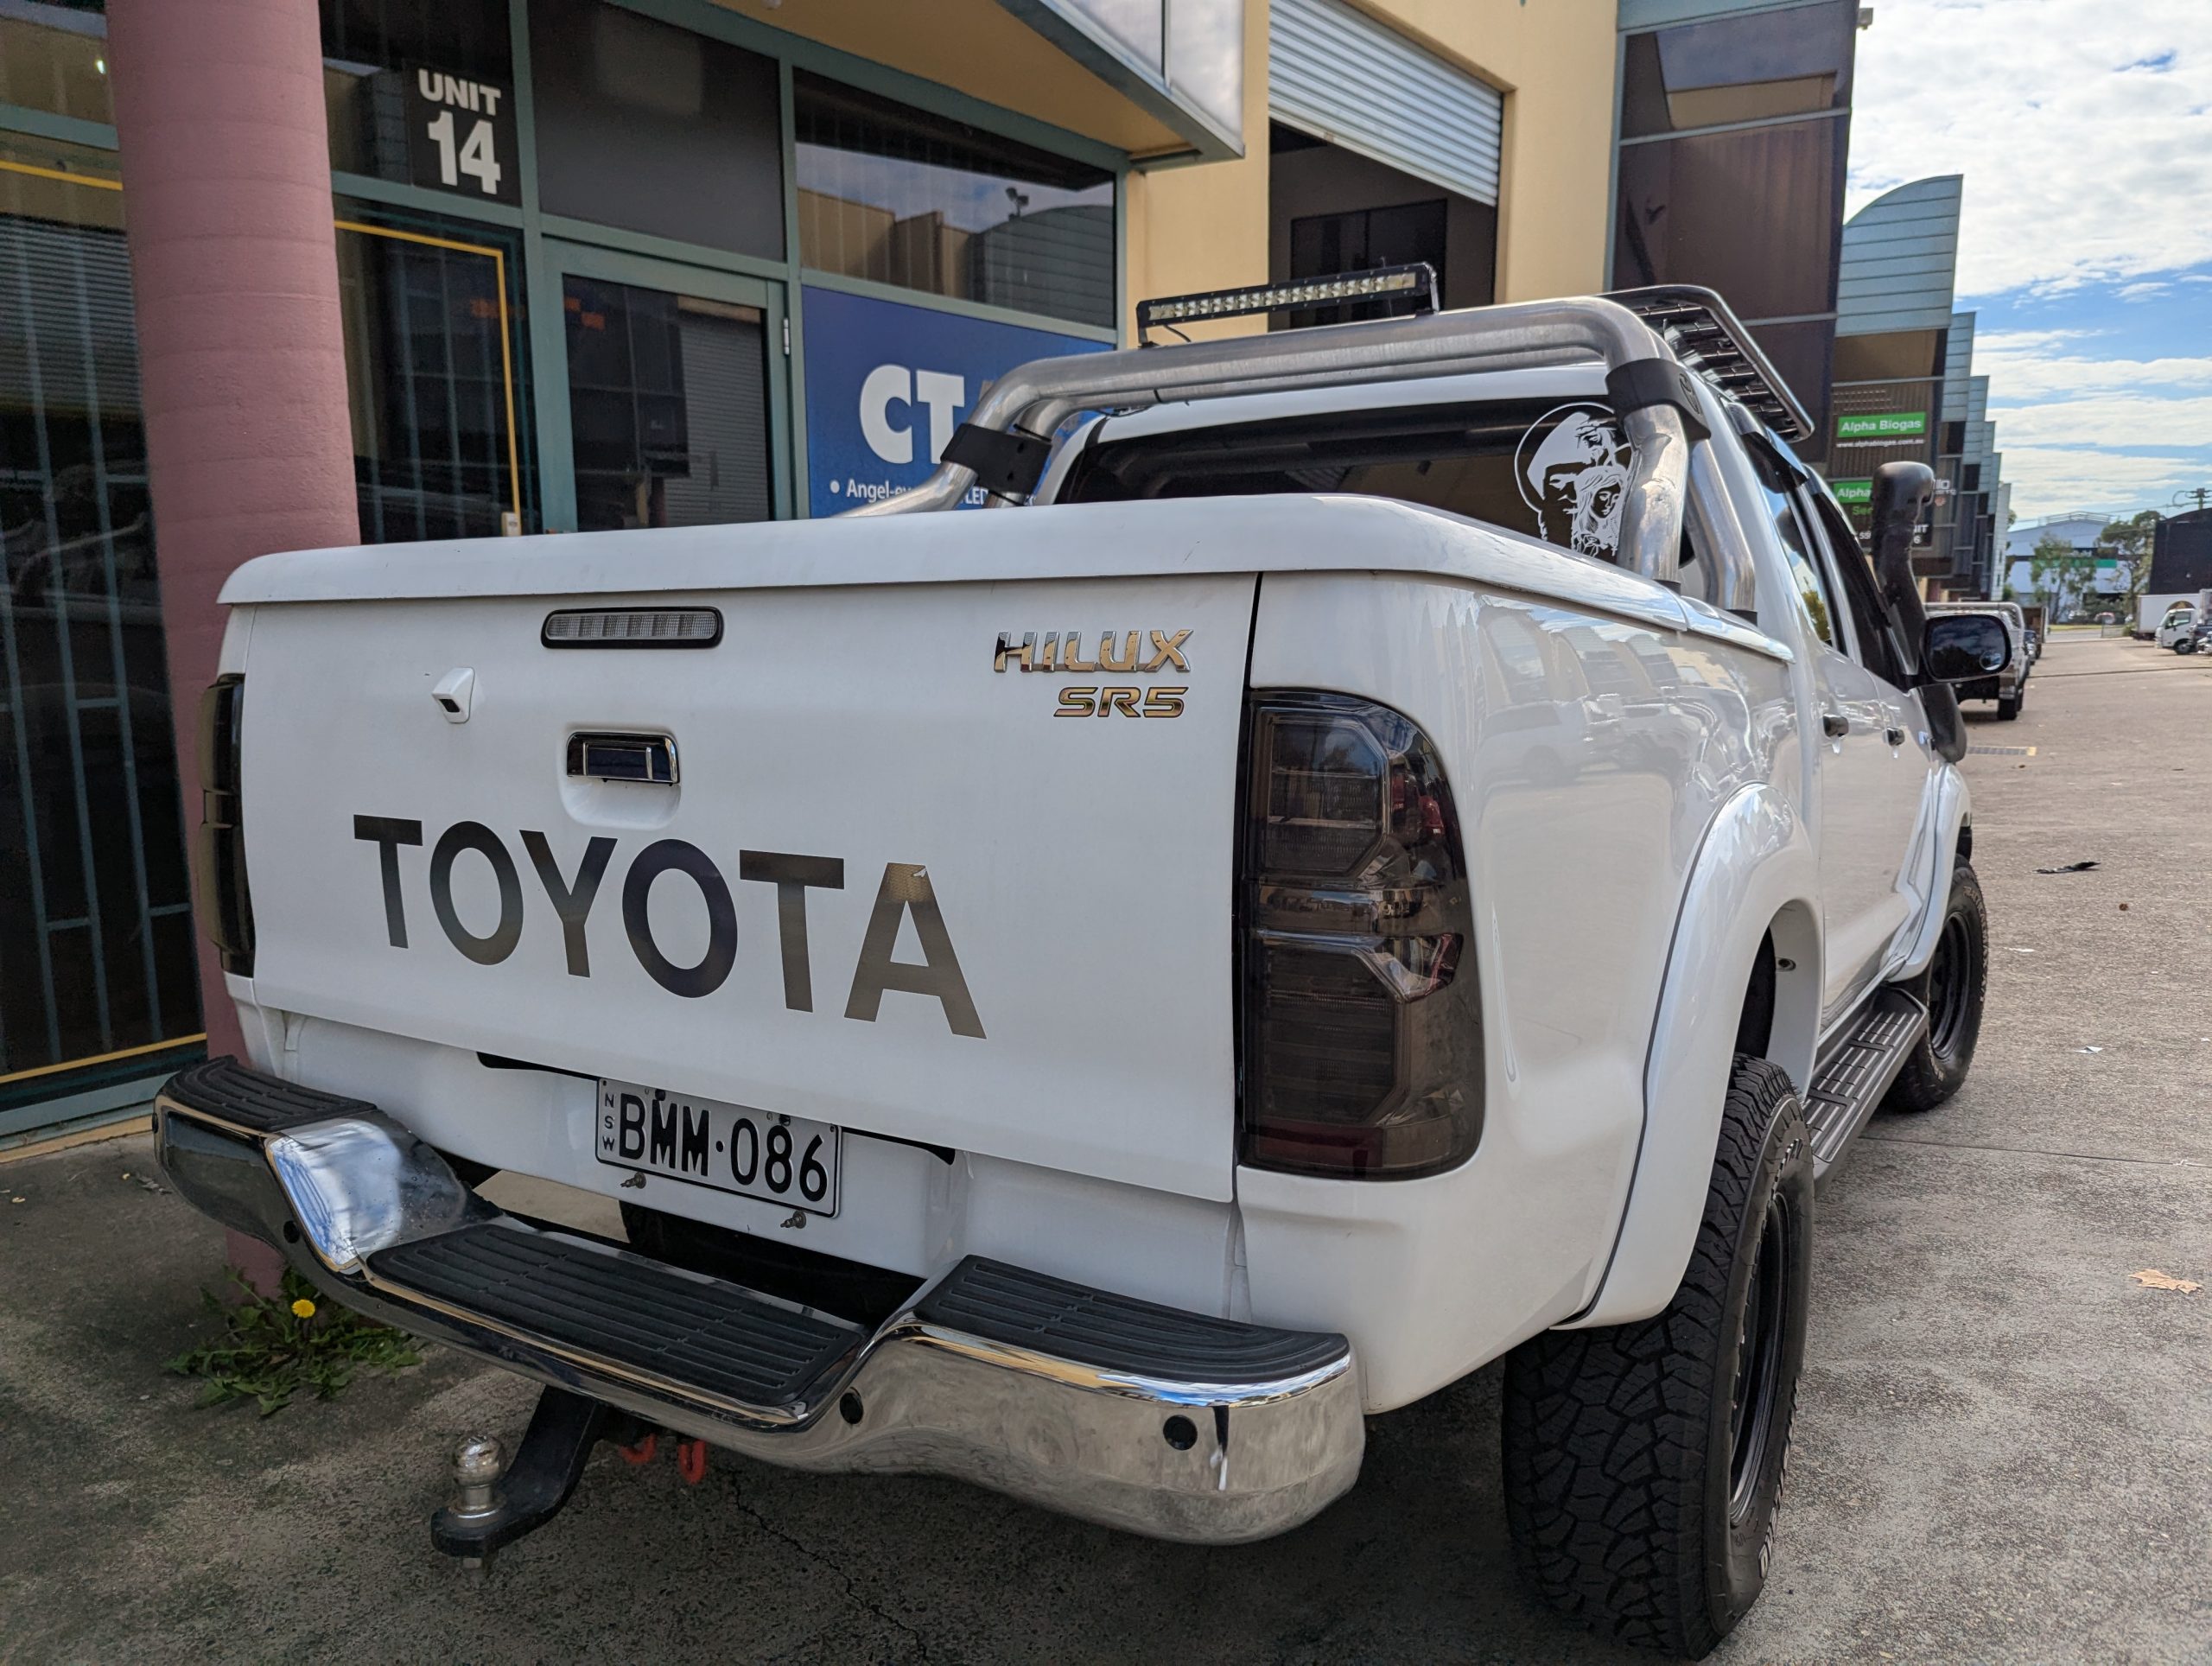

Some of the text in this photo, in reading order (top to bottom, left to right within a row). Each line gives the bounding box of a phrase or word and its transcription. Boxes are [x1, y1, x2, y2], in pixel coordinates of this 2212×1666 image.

[418, 68, 501, 116] UNIT
[427, 110, 501, 194] 14
[860, 364, 965, 464] CT
[1841, 419, 1922, 434] Alpha Biogas
[994, 630, 1194, 672] HILUX
[1053, 687, 1189, 718] SR5
[353, 814, 988, 1040] TOYOTA
